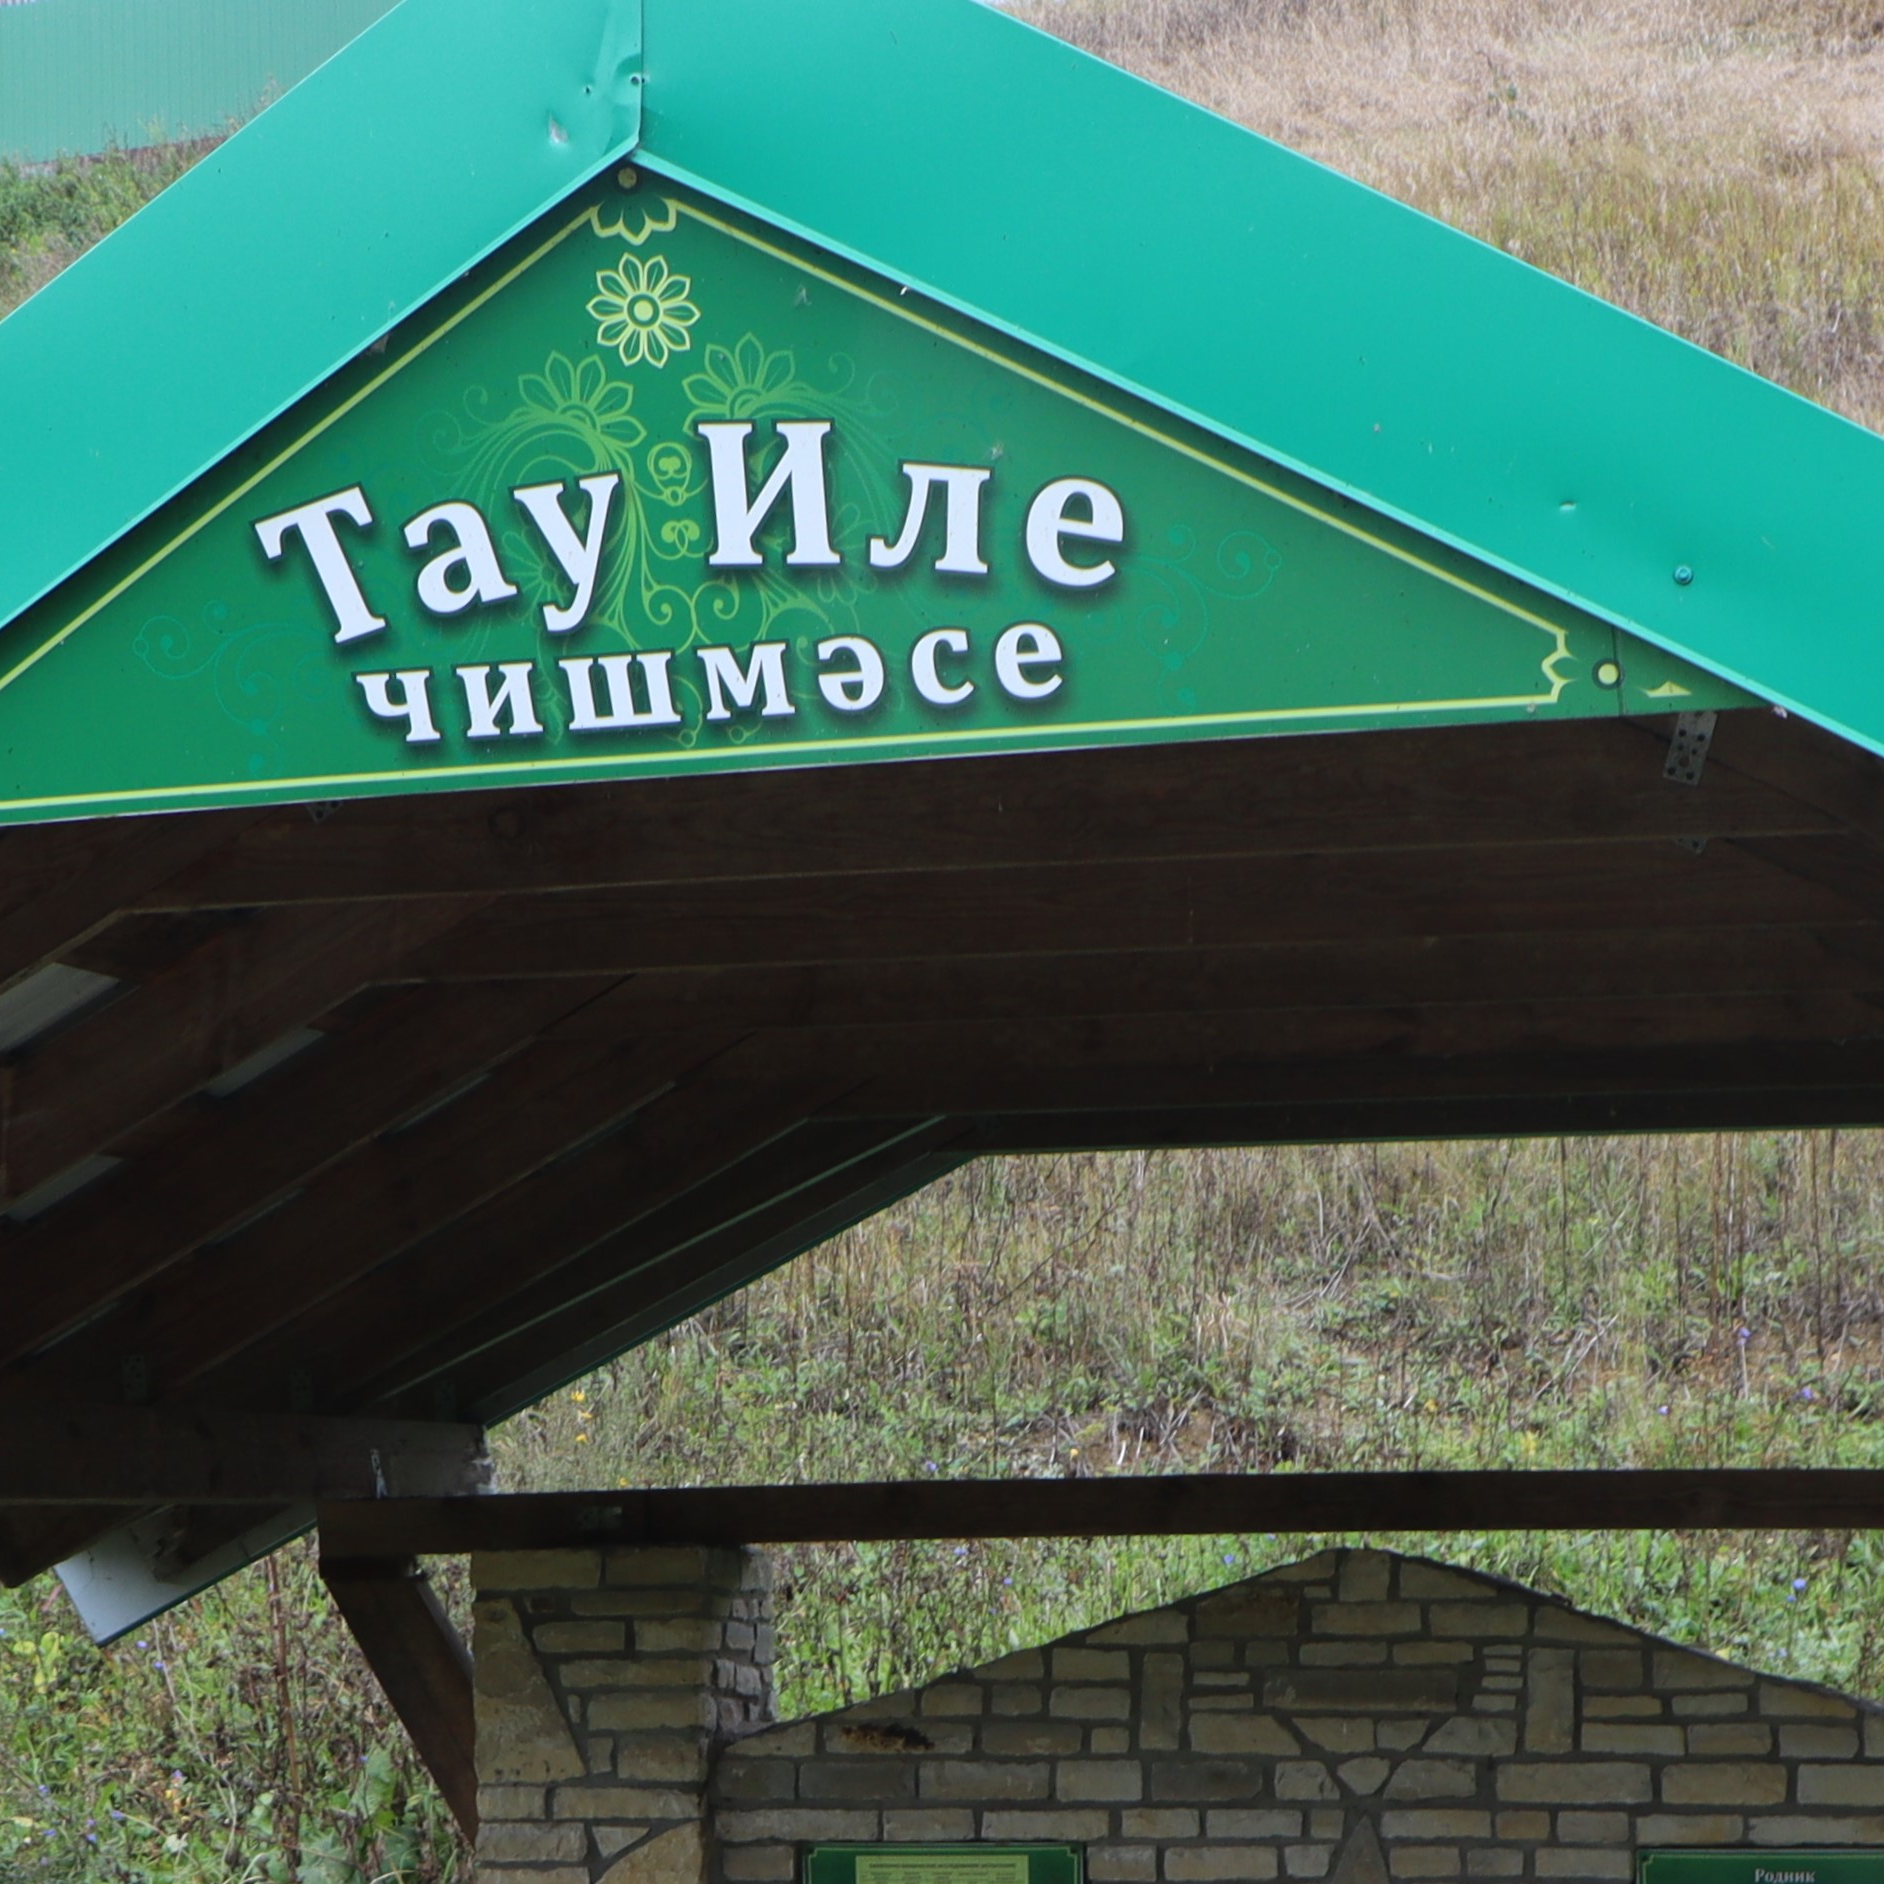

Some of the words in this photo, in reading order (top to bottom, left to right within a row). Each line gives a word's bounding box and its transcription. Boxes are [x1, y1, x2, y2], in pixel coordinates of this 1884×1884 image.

[255, 475, 619, 643] Тау
[698, 423, 1123, 586] Иле
[355, 624, 1063, 742] чишмәсе
[1755, 1868, 1816, 1883] Родник
